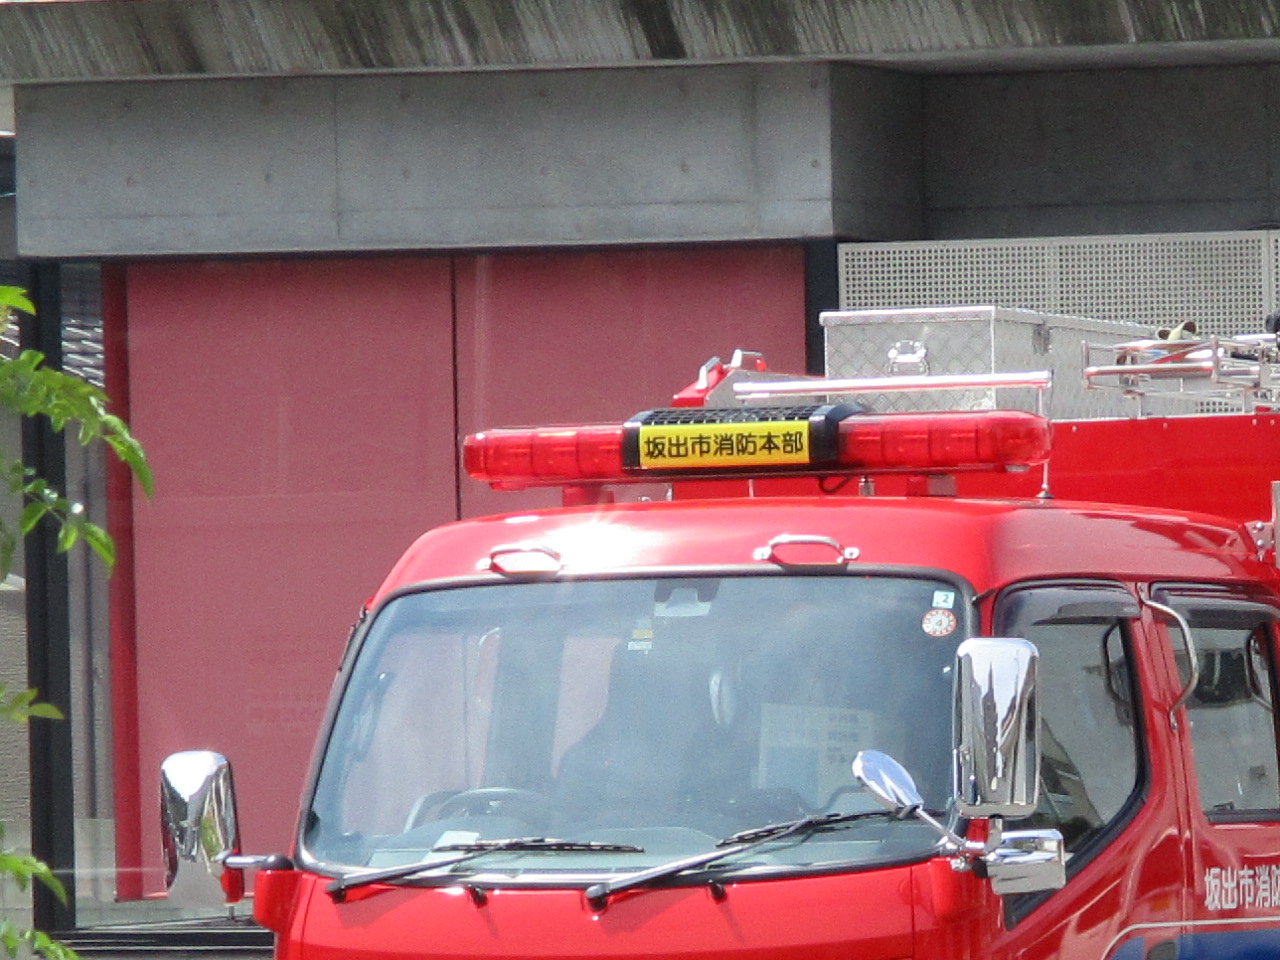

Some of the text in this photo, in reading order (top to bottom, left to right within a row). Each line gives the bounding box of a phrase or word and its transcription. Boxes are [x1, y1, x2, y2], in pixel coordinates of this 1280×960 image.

[644, 431, 803, 460] 坂出市消防本部
